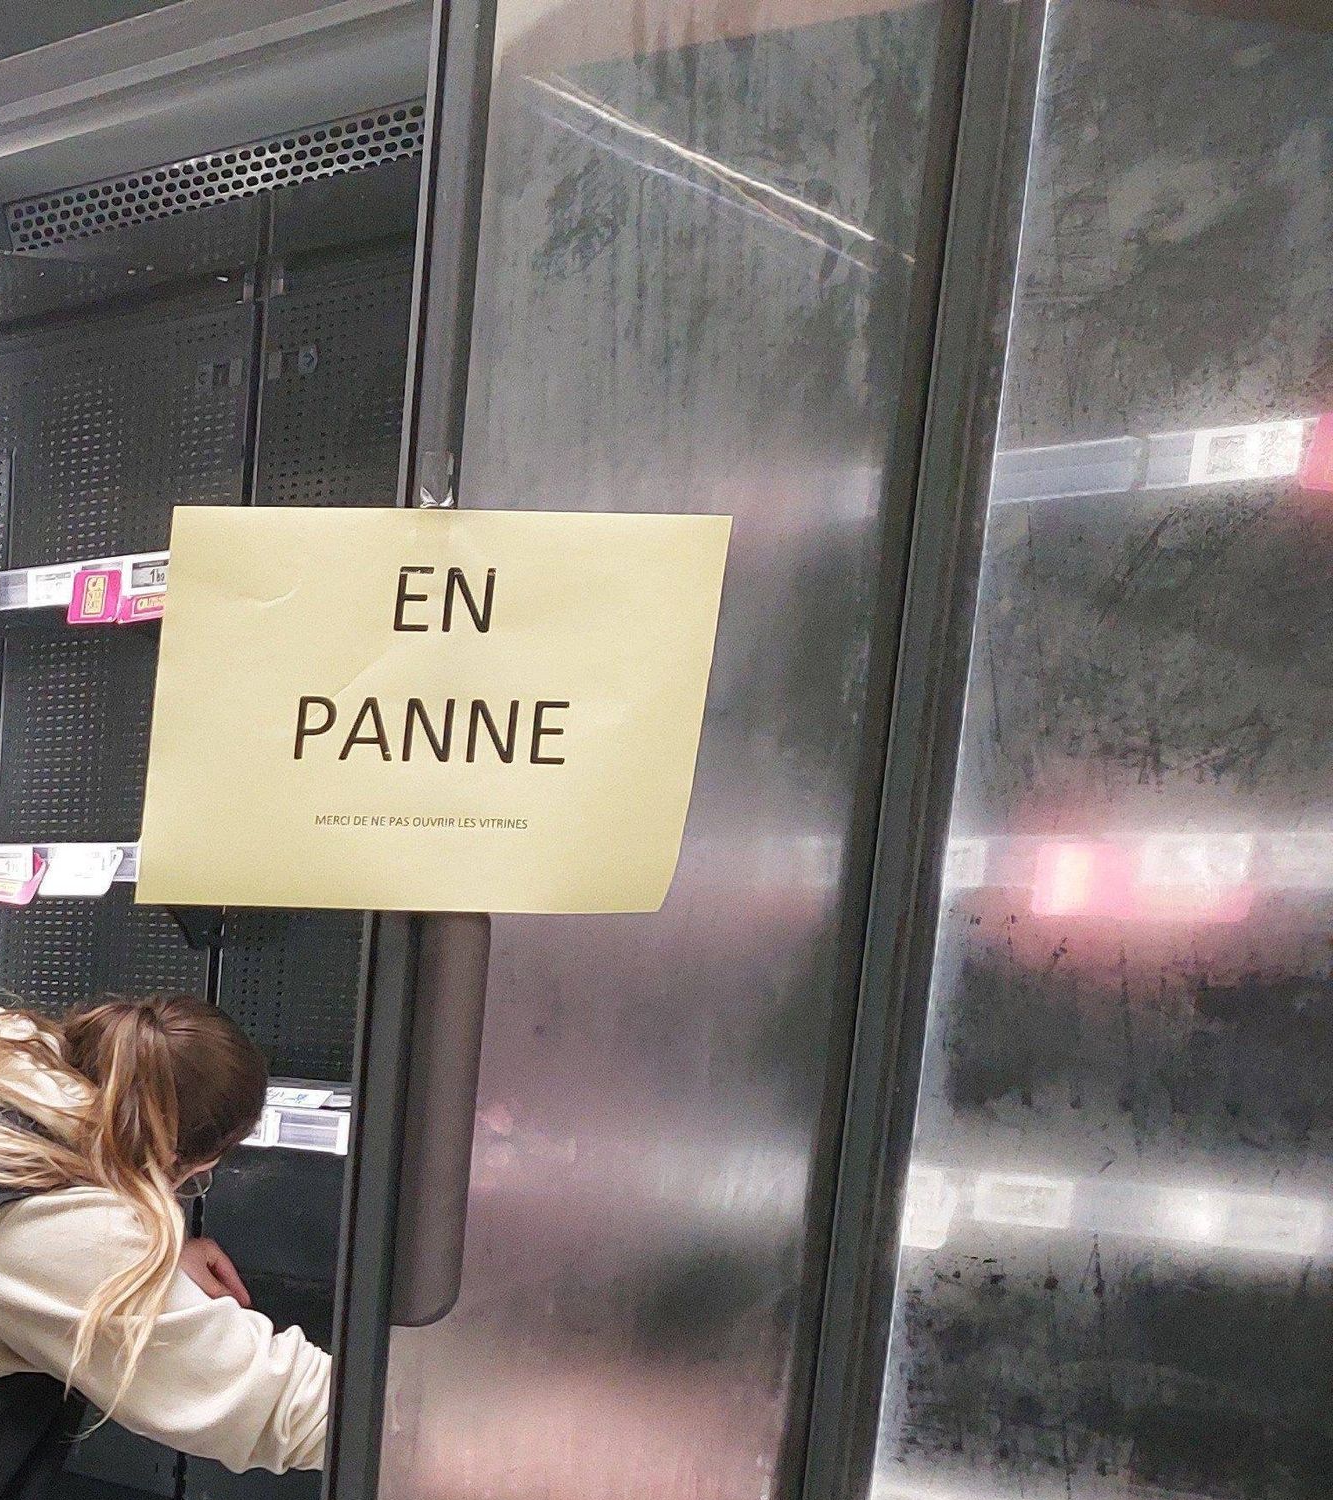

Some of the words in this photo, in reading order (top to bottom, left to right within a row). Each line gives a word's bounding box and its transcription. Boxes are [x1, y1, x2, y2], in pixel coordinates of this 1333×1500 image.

[393, 565, 497, 634] EN
[293, 695, 571, 765] PANNE
[314, 815, 350, 826] MERCI
[353, 816, 368, 826] DE
[371, 816, 386, 827] NE
[389, 816, 410, 827] PAS
[412, 817, 455, 828] OUVRIR
[458, 818, 477, 828] LES
[479, 818, 528, 829] VITRINES
